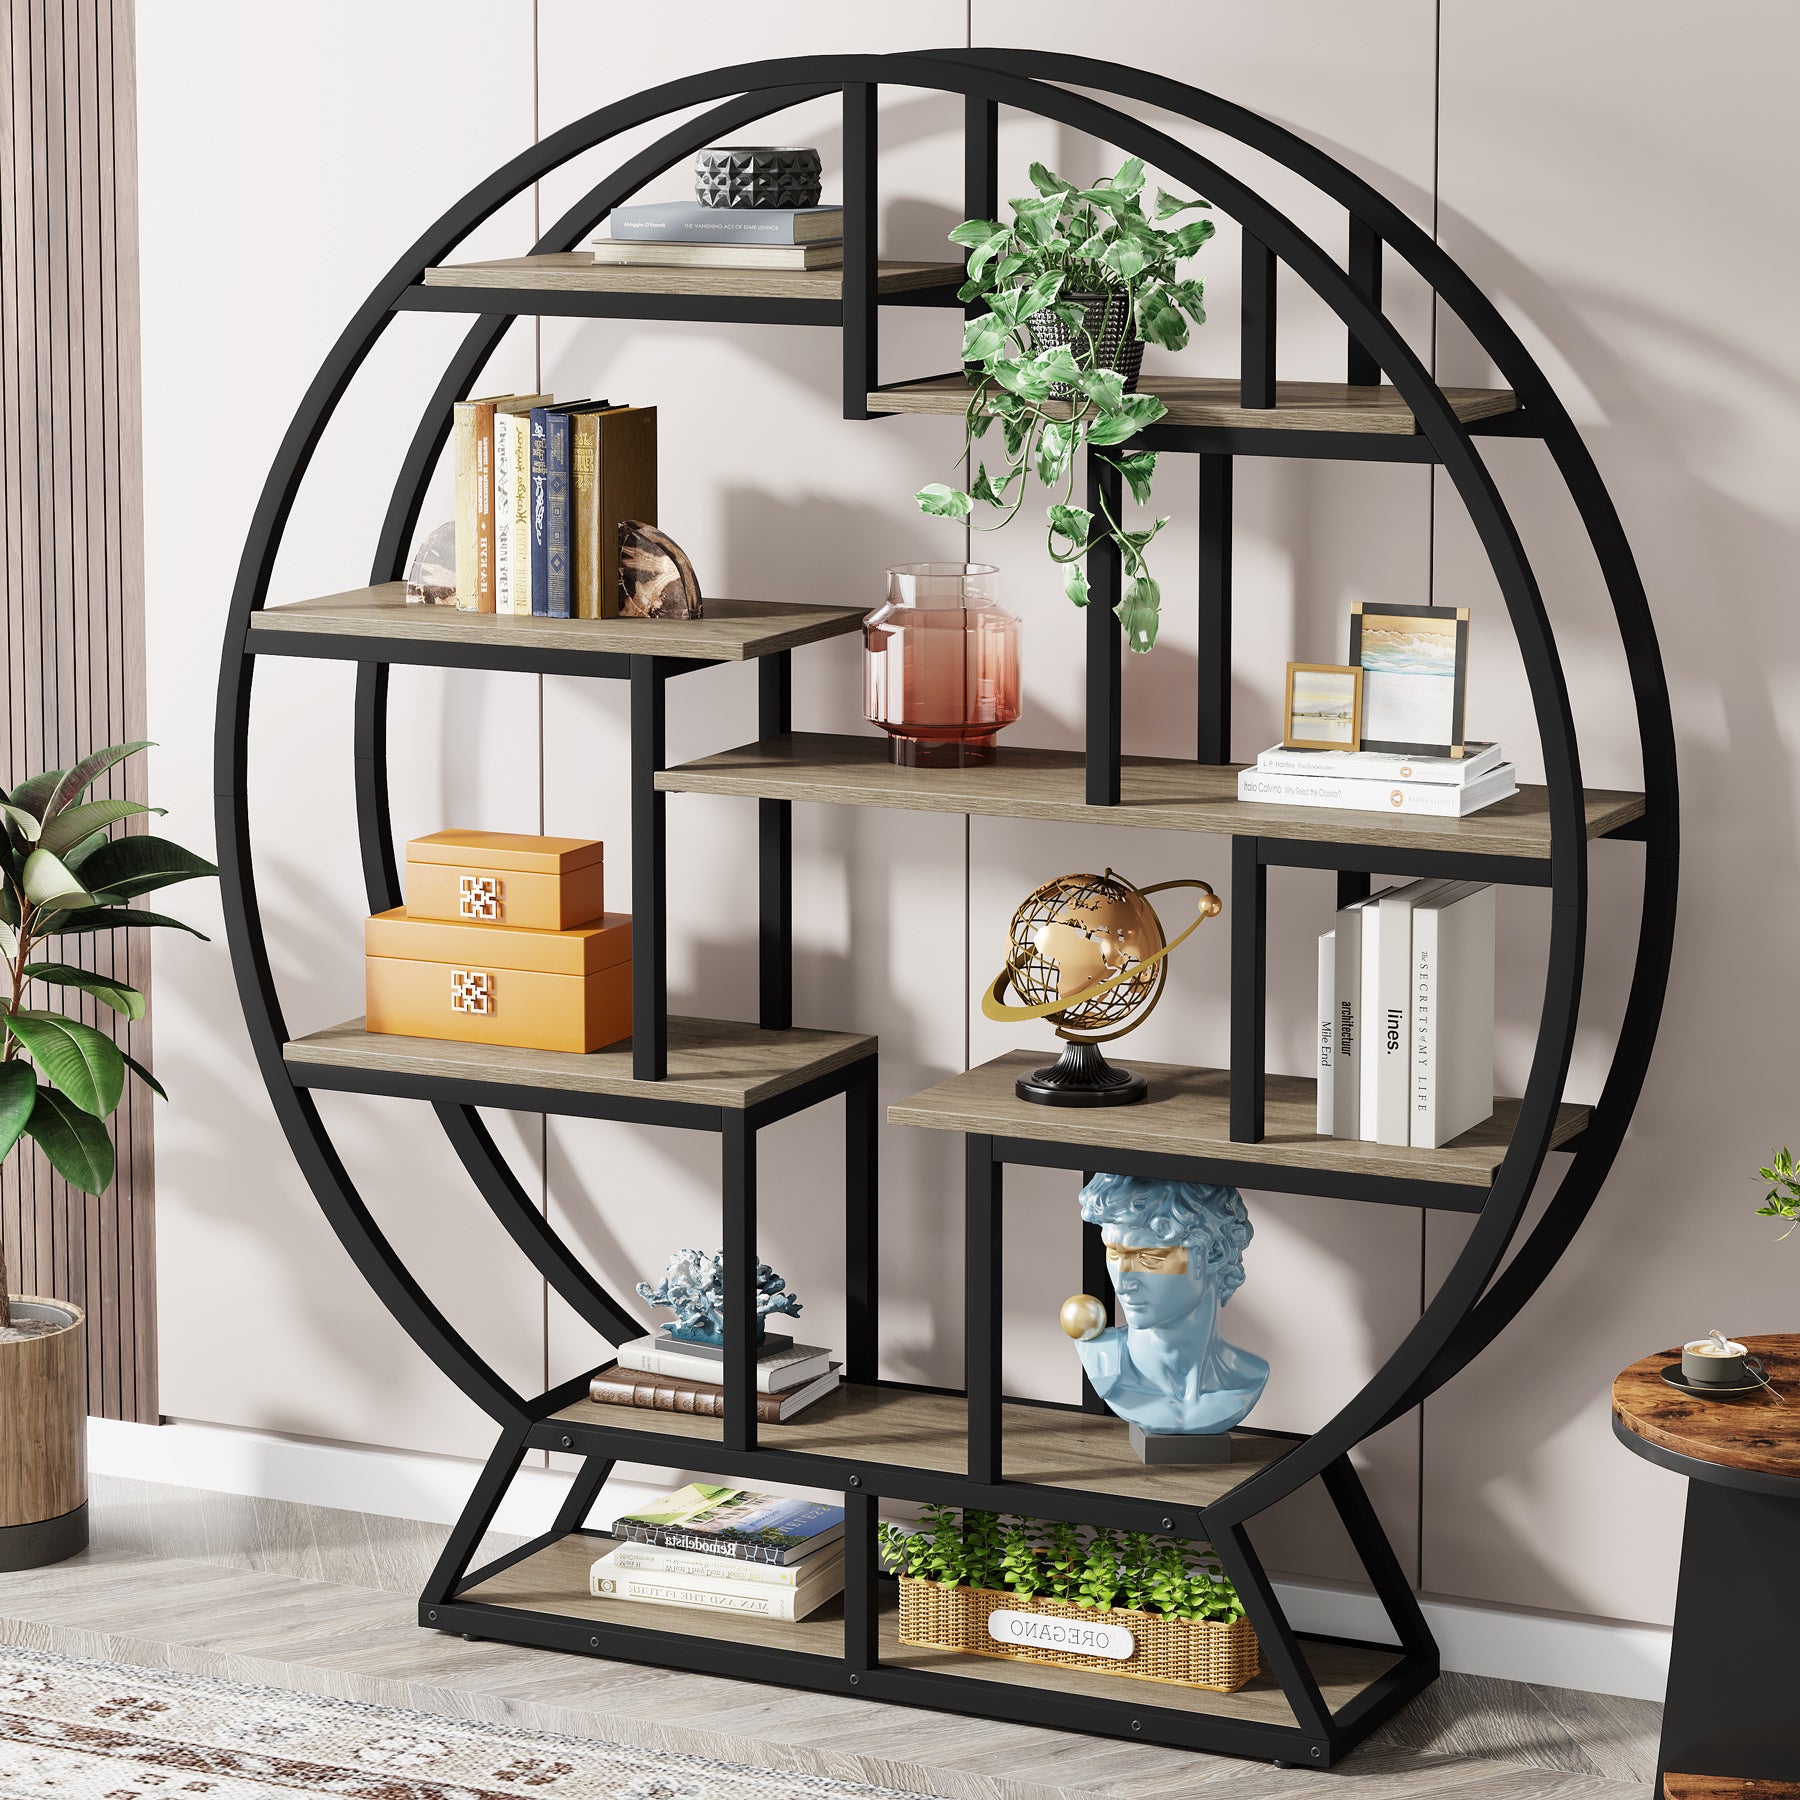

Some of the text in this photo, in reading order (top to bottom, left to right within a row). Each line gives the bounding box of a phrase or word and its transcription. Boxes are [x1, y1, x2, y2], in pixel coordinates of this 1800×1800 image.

[1243, 781, 1257, 792] Italo
[1257, 782, 1282, 794] Calvino
[1419, 963, 1429, 1033] SECRETS
[1321, 1021, 1332, 1067] Mile End
[1341, 1001, 1354, 1057] architectuur
[1387, 1008, 1403, 1056] lines.
[1419, 1044, 1428, 1066] MY
[1418, 1076, 1428, 1112] LIFE
